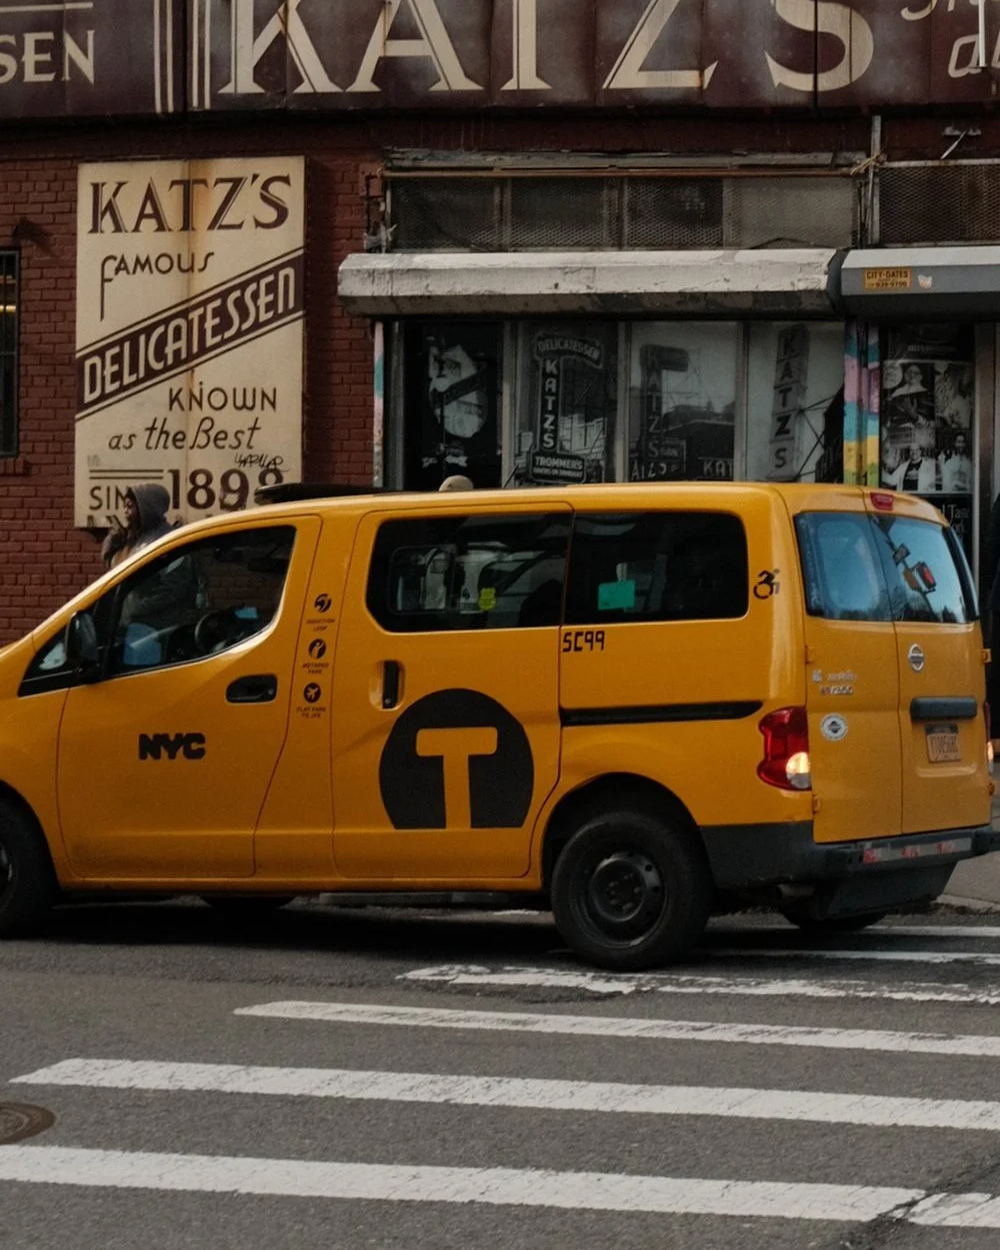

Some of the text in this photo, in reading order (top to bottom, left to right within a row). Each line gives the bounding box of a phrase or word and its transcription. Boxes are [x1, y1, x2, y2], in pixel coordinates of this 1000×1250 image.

[88, 173, 292, 234] KATZ'S
[84, 266, 295, 403] DELICATESSEN
[168, 386, 278, 412] KNOWN
[109, 416, 262, 450] as the Best
[139, 733, 206, 760] NYC
